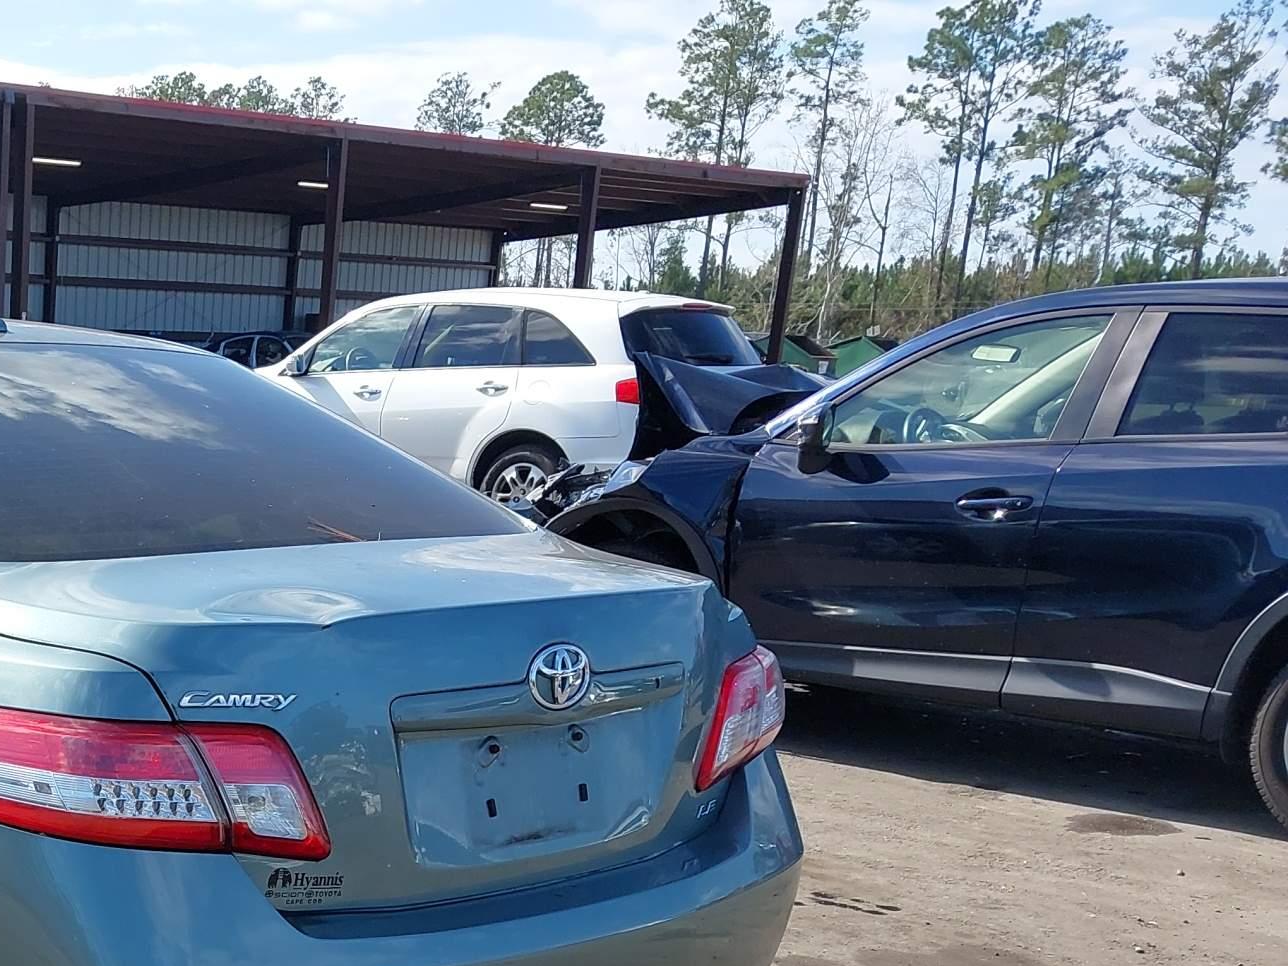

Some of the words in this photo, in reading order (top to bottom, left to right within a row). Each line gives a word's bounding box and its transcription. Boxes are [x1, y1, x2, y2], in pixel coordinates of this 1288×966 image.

[179, 690, 297, 711] CAMRY
[293, 872, 344, 890] Hyannis
[315, 889, 342, 897] TOYOTA
